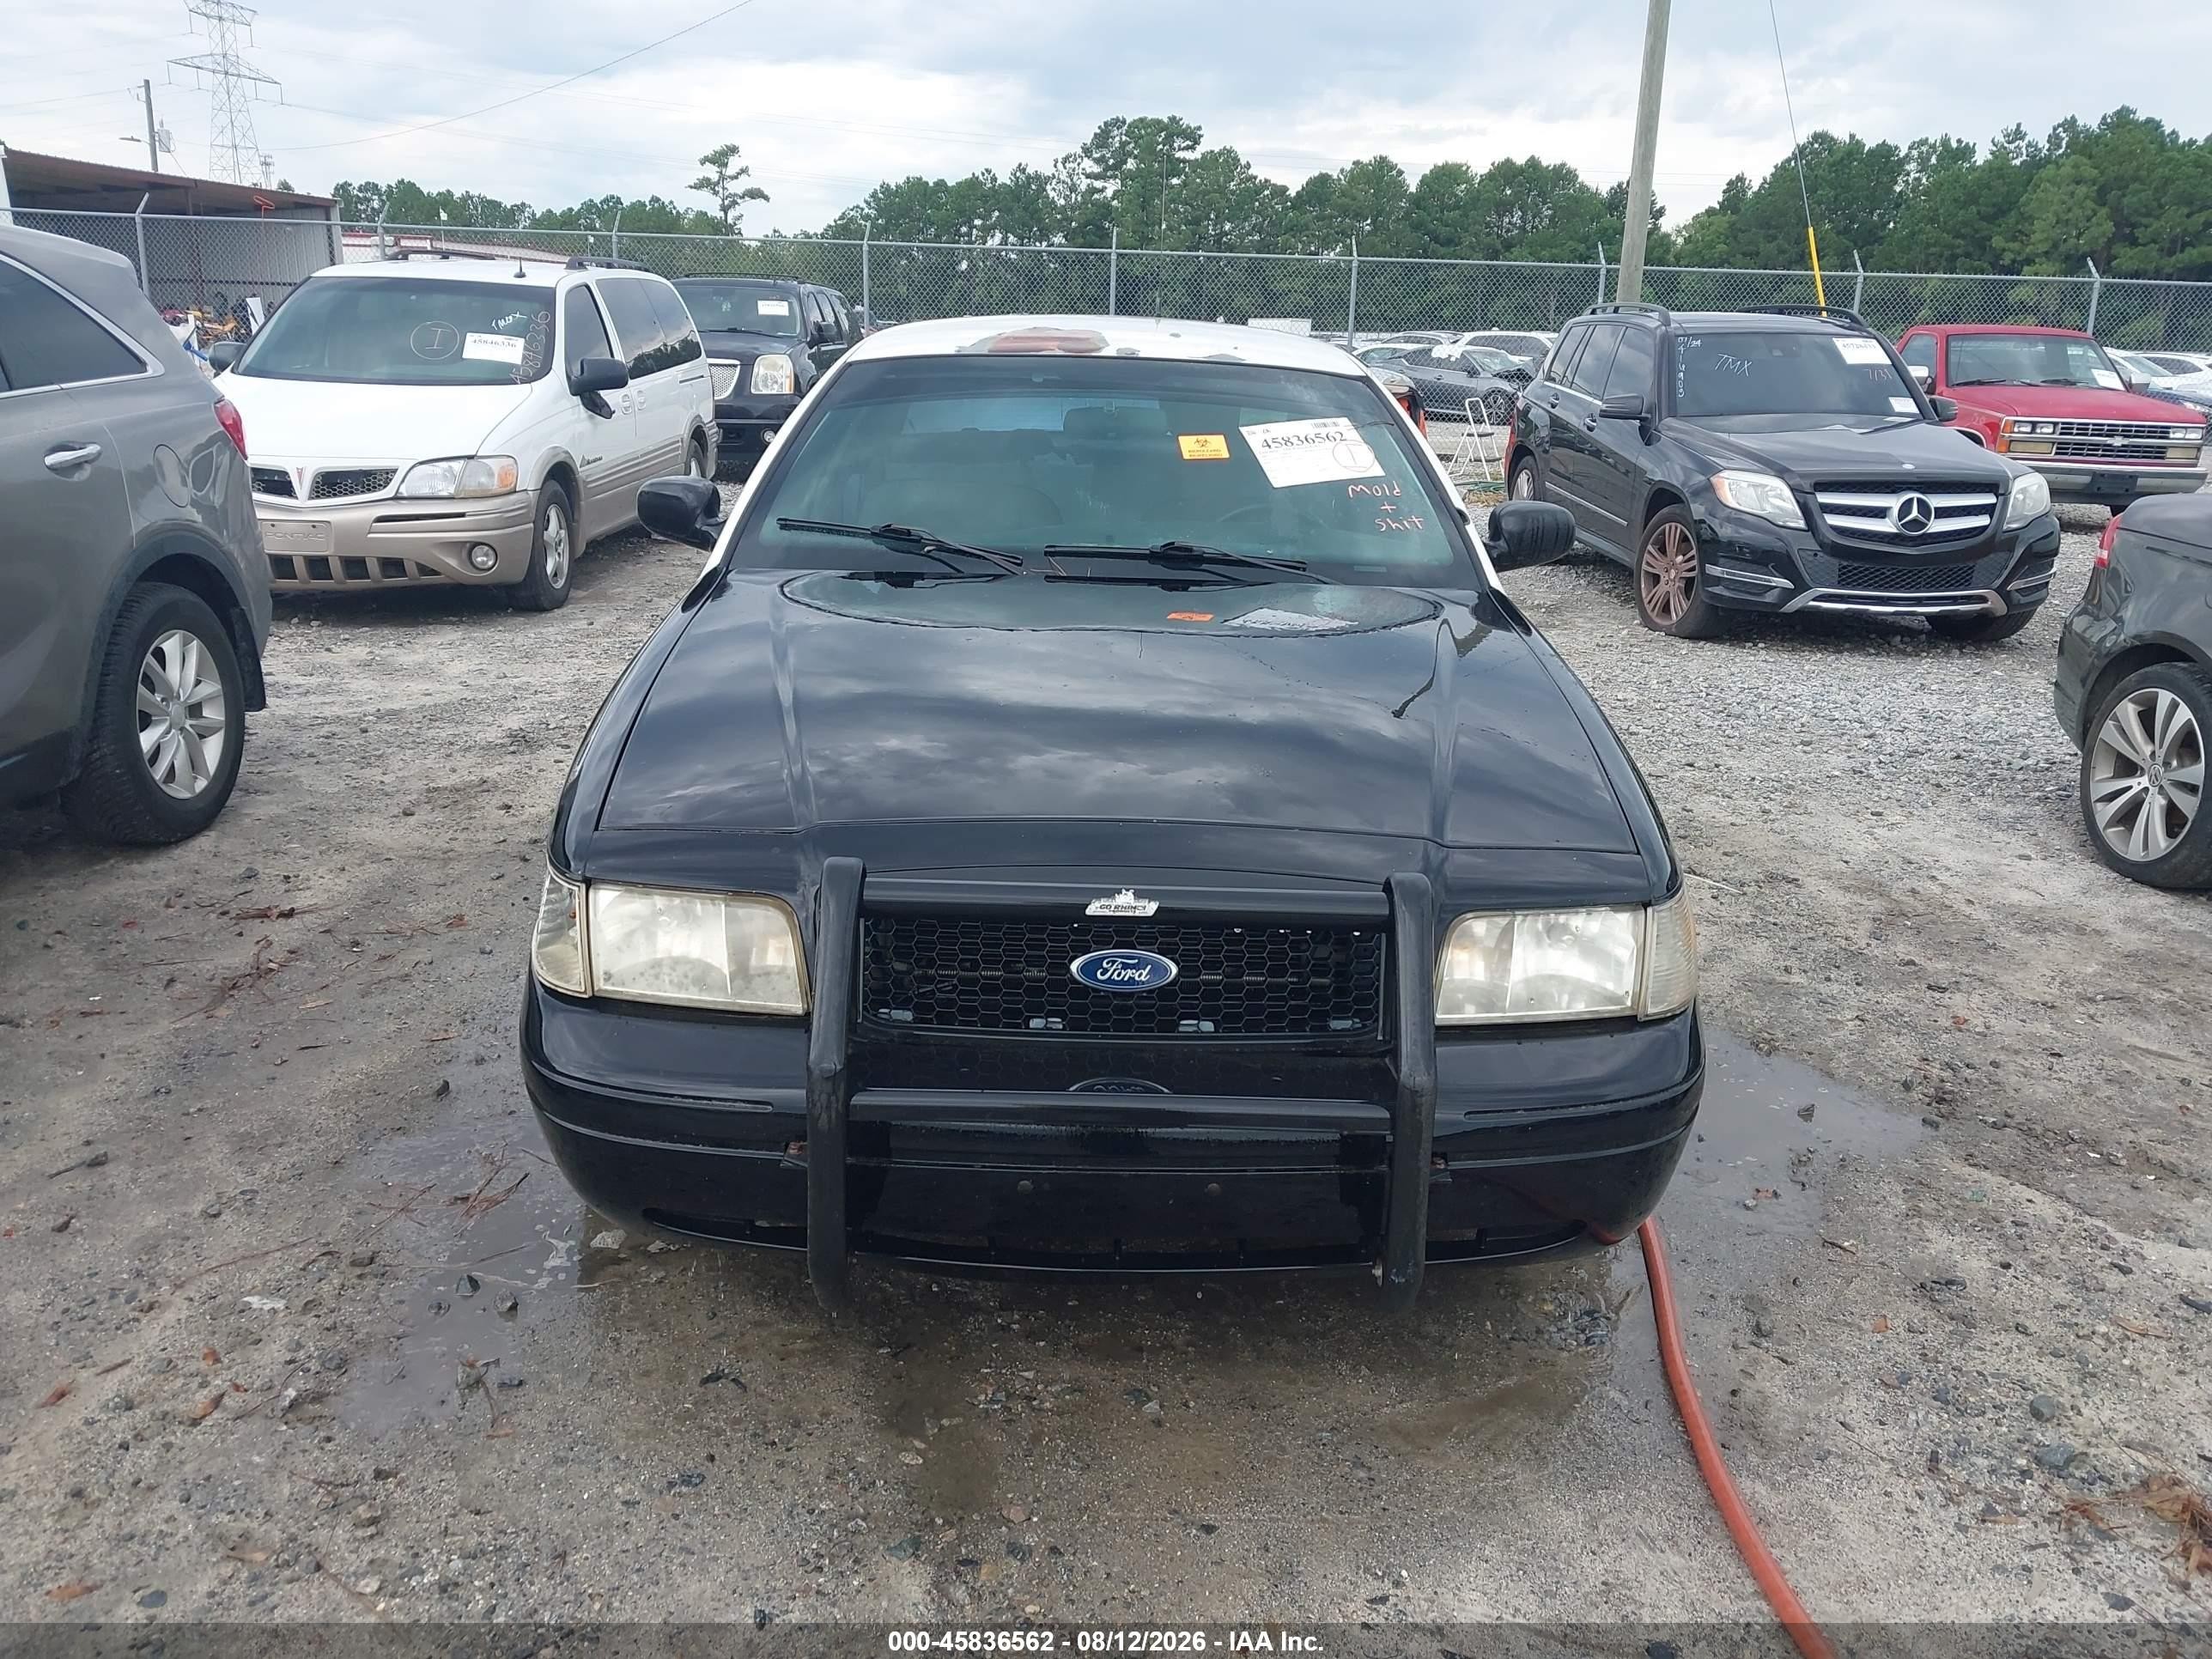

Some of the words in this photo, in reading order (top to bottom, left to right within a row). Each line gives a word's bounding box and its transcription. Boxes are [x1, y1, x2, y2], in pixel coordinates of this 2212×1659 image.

[1715, 353, 1753, 377] TMX
[1261, 431, 1347, 450] 45836562
[1097, 957, 1152, 981] Ford
